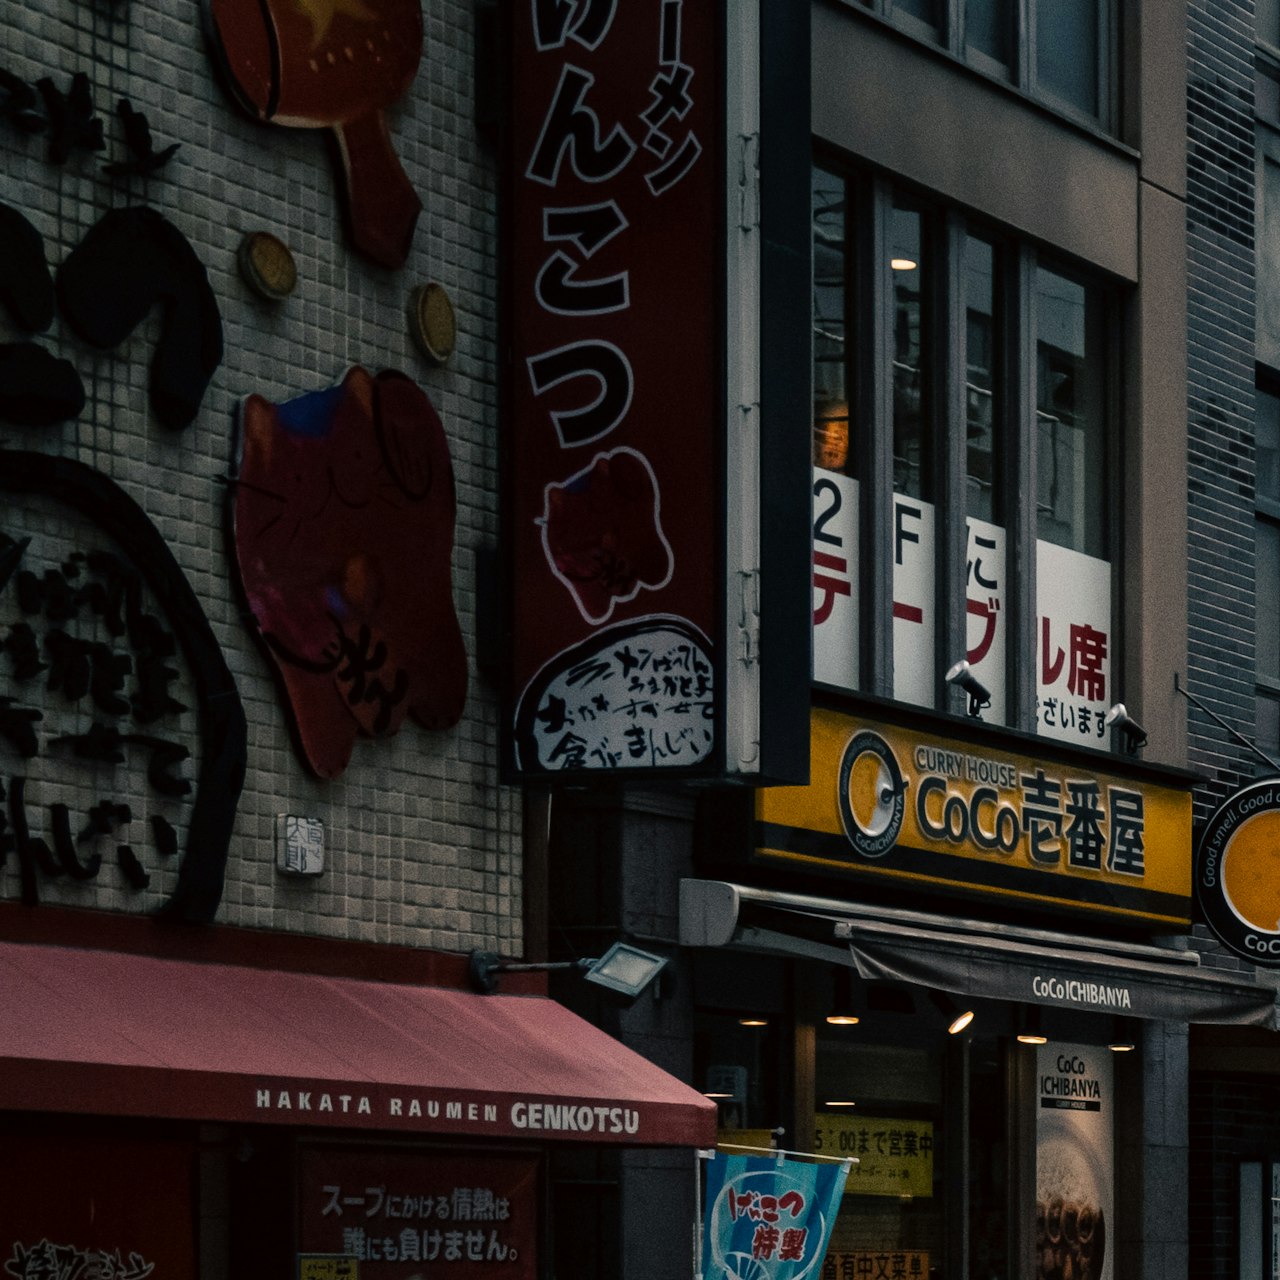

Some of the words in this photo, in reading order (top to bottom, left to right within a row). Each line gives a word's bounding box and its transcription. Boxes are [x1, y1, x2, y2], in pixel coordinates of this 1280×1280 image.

[916, 747, 964, 777] CURRY
[966, 757, 1017, 788] HOUSE
[915, 767, 1145, 877] CoCo壱番屋
[1203, 848, 1218, 888] Good
[1238, 788, 1274, 815] Good
[1057, 1055, 1085, 1074] CoCo
[1041, 1076, 1101, 1098] ICHIBANYA
[256, 1089, 371, 1114] HAKATA
[390, 1097, 497, 1122] RAUMEN
[511, 1102, 640, 1134] GENKOTSU
[321, 1184, 511, 1221] スープにかける情熱は
[751, 1223, 809, 1262] 特製
